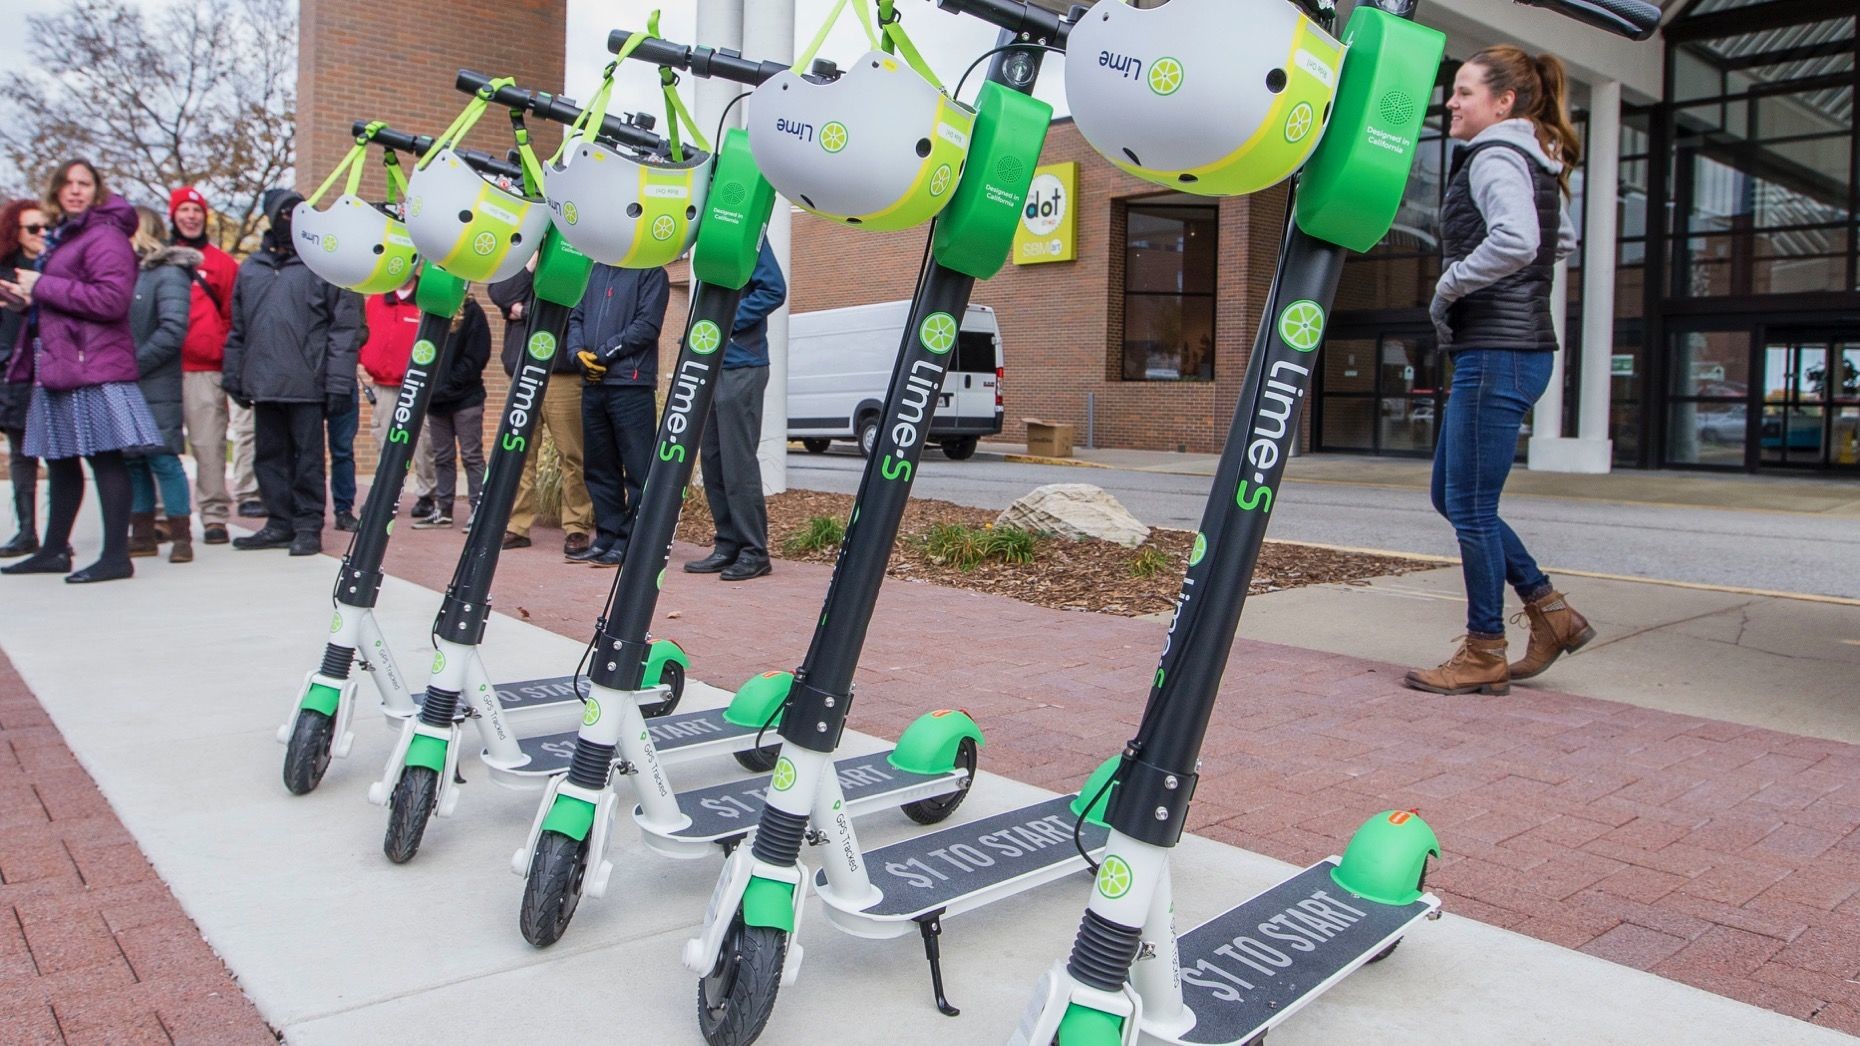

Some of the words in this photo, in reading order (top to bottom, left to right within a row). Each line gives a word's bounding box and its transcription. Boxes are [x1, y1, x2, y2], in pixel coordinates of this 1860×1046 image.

[1099, 50, 1142, 81] Lime
[776, 118, 813, 142] Lime
[1367, 126, 1403, 144] Designed
[1402, 136, 1410, 147] in
[1368, 136, 1403, 154] California
[985, 183, 1014, 199] Designed
[986, 192, 1014, 207] California
[1025, 188, 1061, 219] dot
[301, 230, 320, 246] Lime
[483, 694, 494, 711] GPS
[490, 710, 506, 741] Tracked
[644, 743, 655, 763] GPS
[651, 762, 668, 797] Tracked
[700, 794, 756, 819] $1
[838, 764, 894, 789] ART
[836, 813, 848, 835] GPS
[841, 833, 859, 873] Tracked
[885, 857, 950, 889] $1
[928, 843, 995, 873] TO
[978, 814, 1086, 858] START
[1258, 890, 1368, 952] START
[1213, 936, 1293, 977] TO
[1181, 958, 1256, 1003] $1
